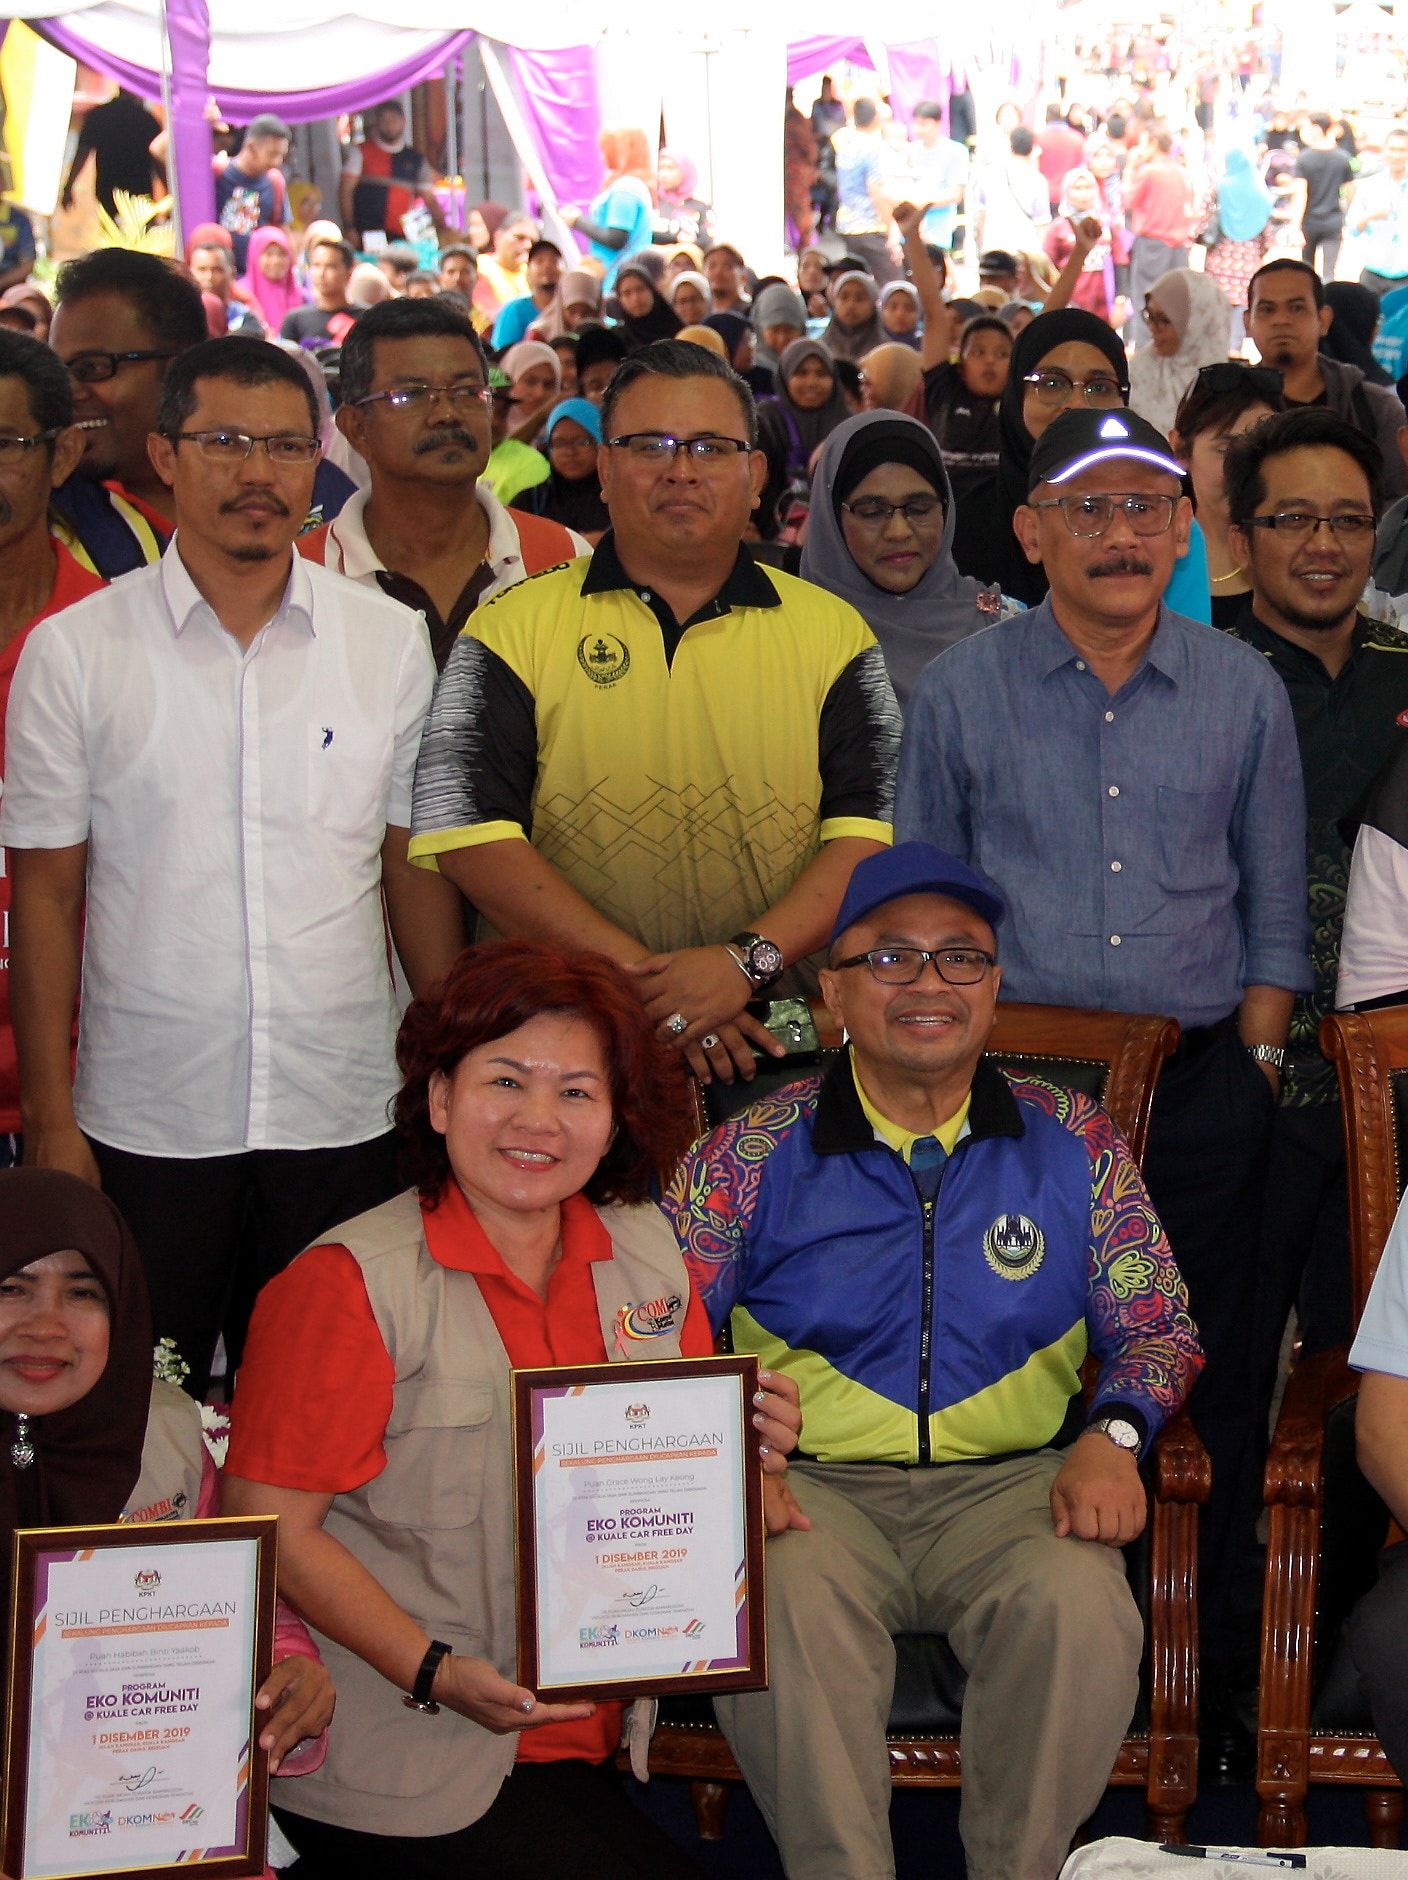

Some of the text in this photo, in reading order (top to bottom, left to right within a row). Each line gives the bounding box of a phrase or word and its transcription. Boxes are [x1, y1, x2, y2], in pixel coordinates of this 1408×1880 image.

[552, 1432, 725, 1457] SIJIL PENGHARGAAN
[620, 1507, 661, 1516] PROGRAM
[587, 1512, 694, 1532] EKO KOMUNITI
[585, 1526, 694, 1543] @ KUALE CAR FREE DAY
[594, 1548, 688, 1565] 1 DISEMBER 2019
[55, 1601, 237, 1627] SIJIL PENGHARGAAN
[122, 1682, 166, 1692] PROGRAM
[86, 1688, 199, 1709] EKO KOMUNITI
[84, 1703, 199, 1721] @ KUALE CAR FREE DAY
[92, 1726, 191, 1744] 1 DISEMBER 2019
